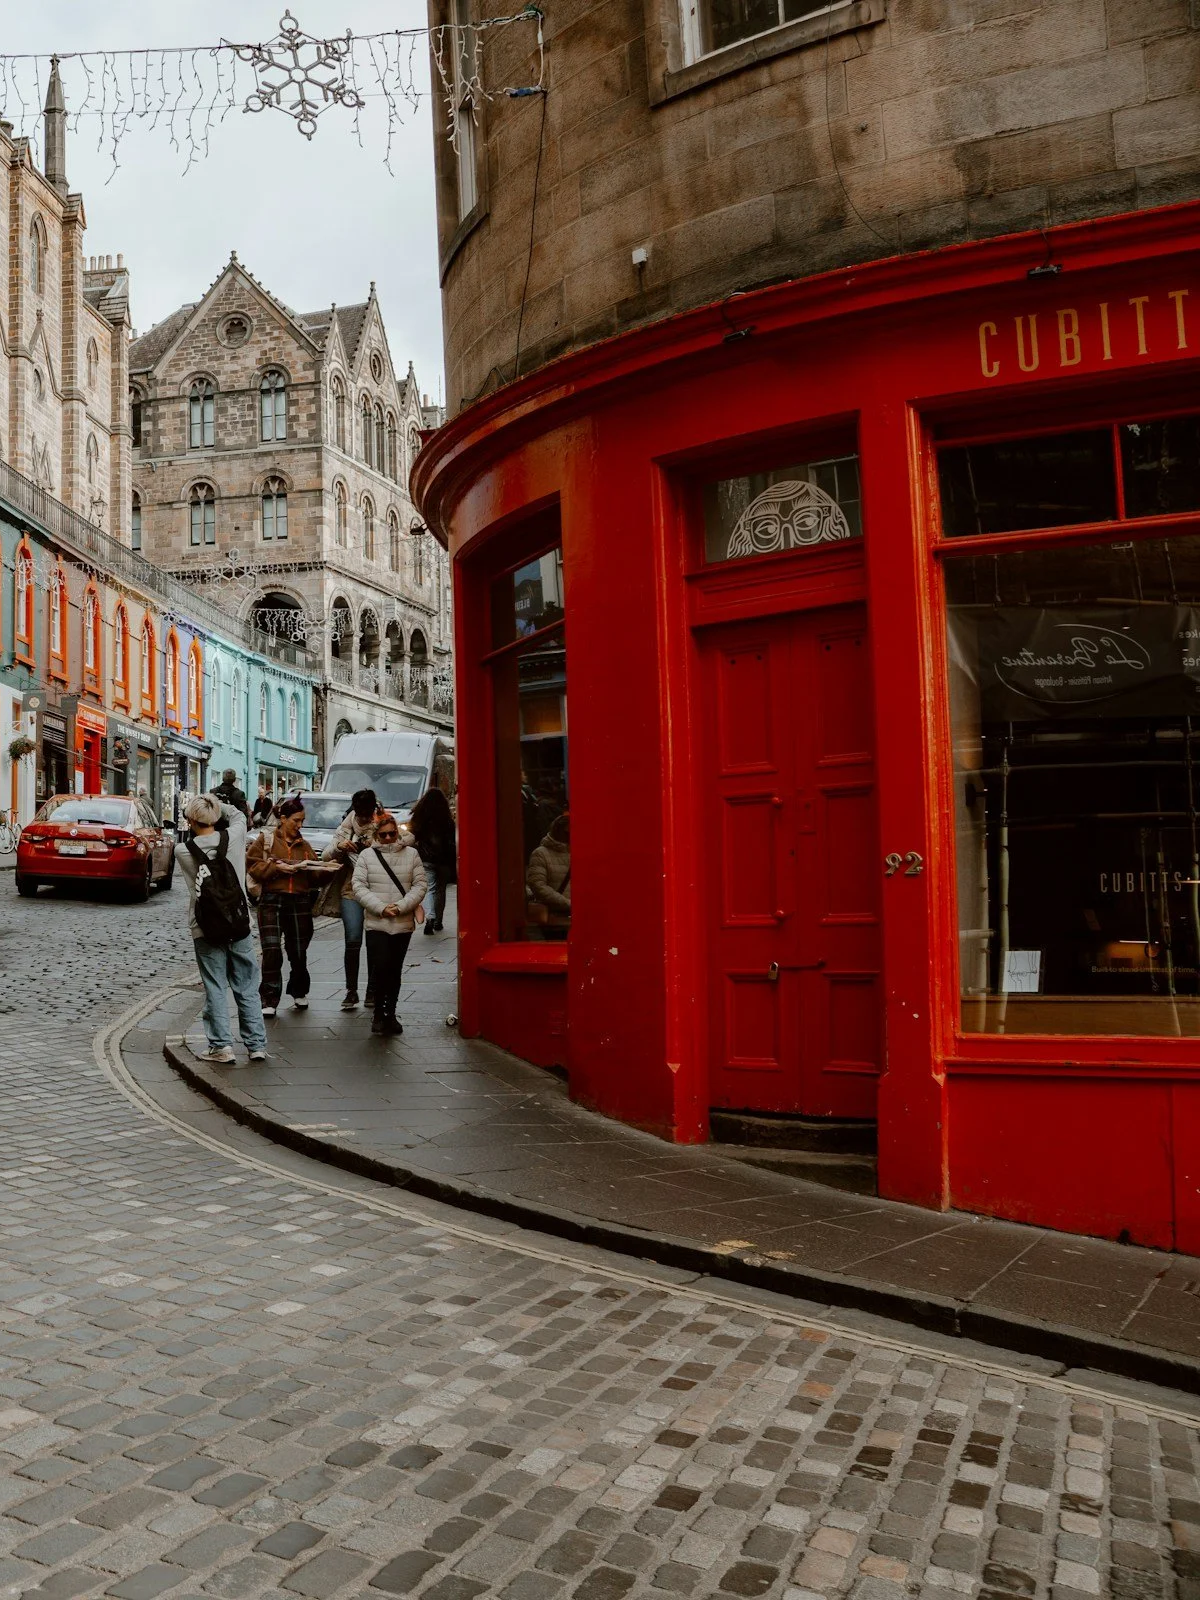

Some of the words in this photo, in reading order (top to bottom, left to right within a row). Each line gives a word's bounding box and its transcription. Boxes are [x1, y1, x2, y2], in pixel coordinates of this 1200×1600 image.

[117, 724, 125, 735] THE
[884, 851, 924, 875] 92
[1100, 871, 1182, 893] CUBITTS
